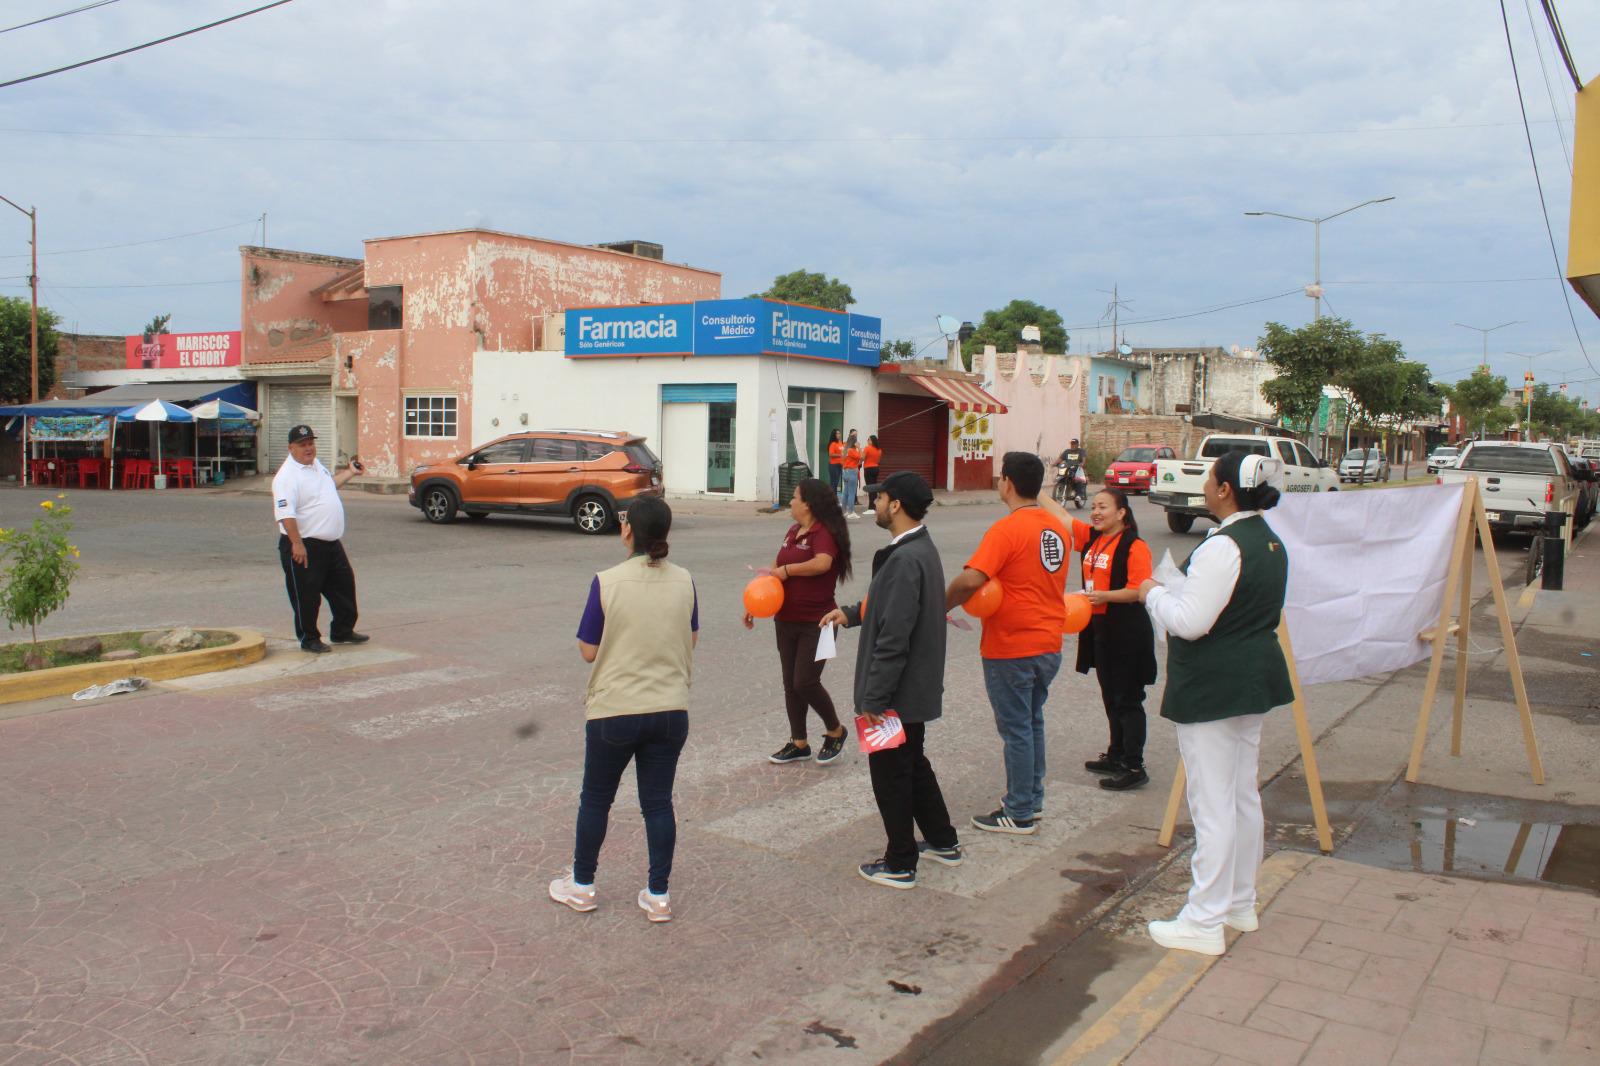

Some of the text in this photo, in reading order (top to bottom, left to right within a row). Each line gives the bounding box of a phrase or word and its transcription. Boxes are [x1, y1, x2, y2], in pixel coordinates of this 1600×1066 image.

[579, 313, 678, 341] Farmacia
[702, 314, 756, 326] Consultorio
[721, 325, 755, 336] Médico
[772, 311, 841, 345] Farmacia
[850, 327, 880, 341] Consultorio
[176, 334, 230, 351] MARISCOS
[861, 339, 880, 350] Médico
[180, 350, 227, 367] EL CHORY
